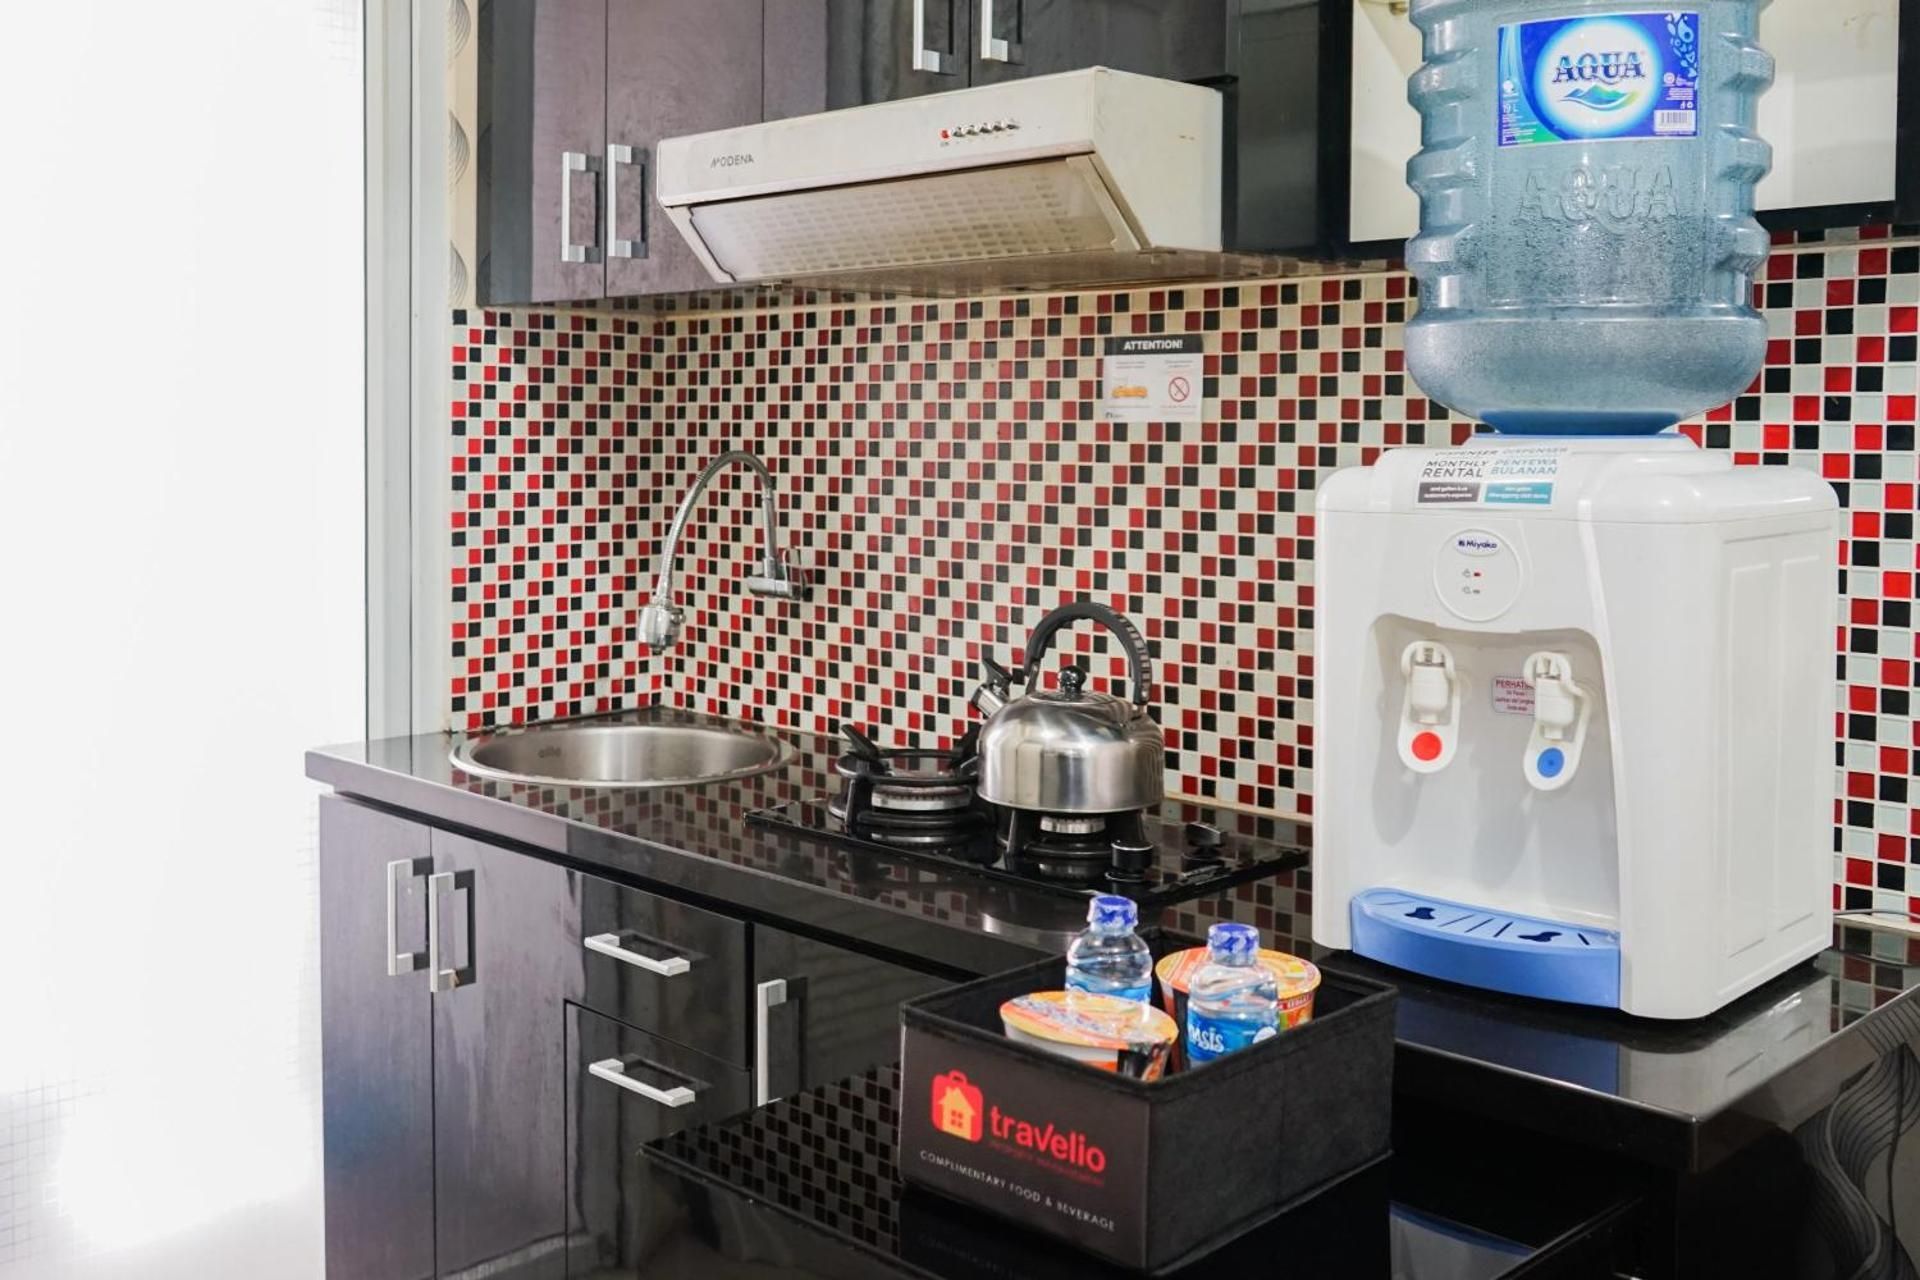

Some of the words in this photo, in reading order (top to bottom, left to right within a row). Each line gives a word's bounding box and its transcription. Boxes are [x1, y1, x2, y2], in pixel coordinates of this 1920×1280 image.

[1552, 51, 1645, 84] AQUA
[710, 153, 754, 169] MODENA
[1511, 164, 1681, 230] AQUA
[1123, 339, 1183, 350] ATTENTION!
[1494, 458, 1558, 466] PENYEWA
[1422, 467, 1484, 478] RENTAL
[1490, 466, 1558, 475] BULANAN
[1466, 540, 1498, 549] Miyako
[990, 1105, 1106, 1173] travelio
[919, 1150, 1006, 1189] COMPLIMENTARY
[1009, 1182, 1041, 1203] FOOD
[1045, 1197, 1053, 1207] &
[1057, 1201, 1115, 1232] BEVERAGE
